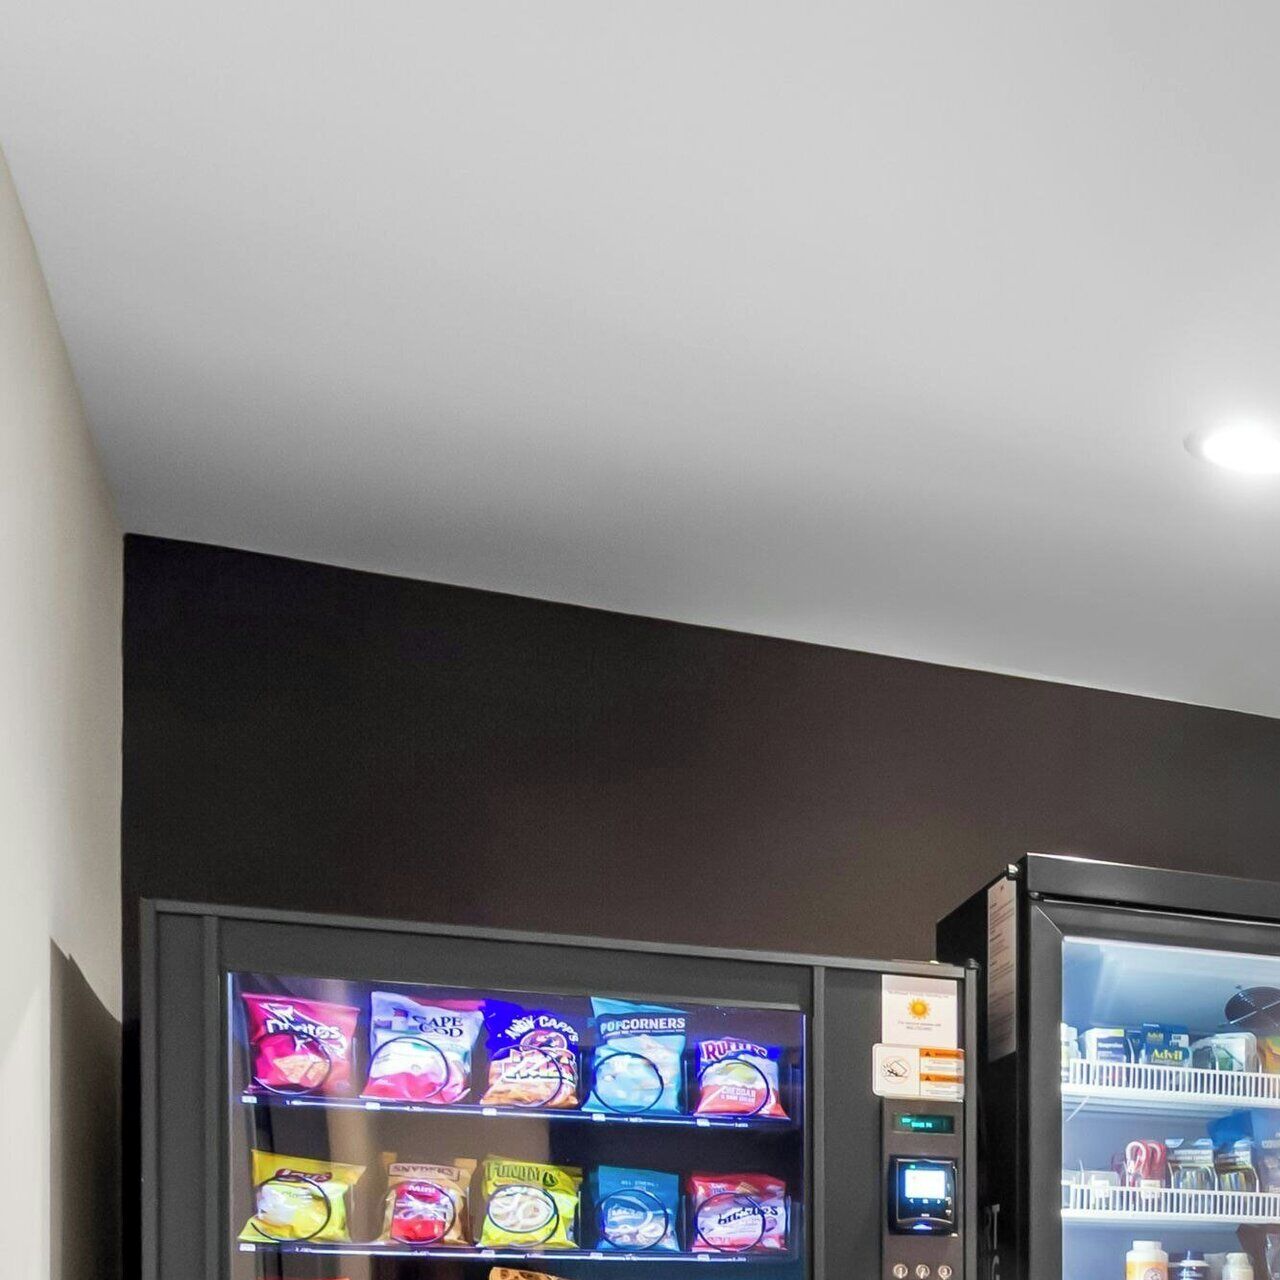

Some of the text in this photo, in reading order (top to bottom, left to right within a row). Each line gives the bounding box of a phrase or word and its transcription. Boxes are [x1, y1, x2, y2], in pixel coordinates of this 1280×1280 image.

[412, 1015, 464, 1028] CAPE
[600, 1017, 686, 1035] POPCORNERS
[418, 1022, 464, 1038] COD
[1151, 1049, 1183, 1061] Advil
